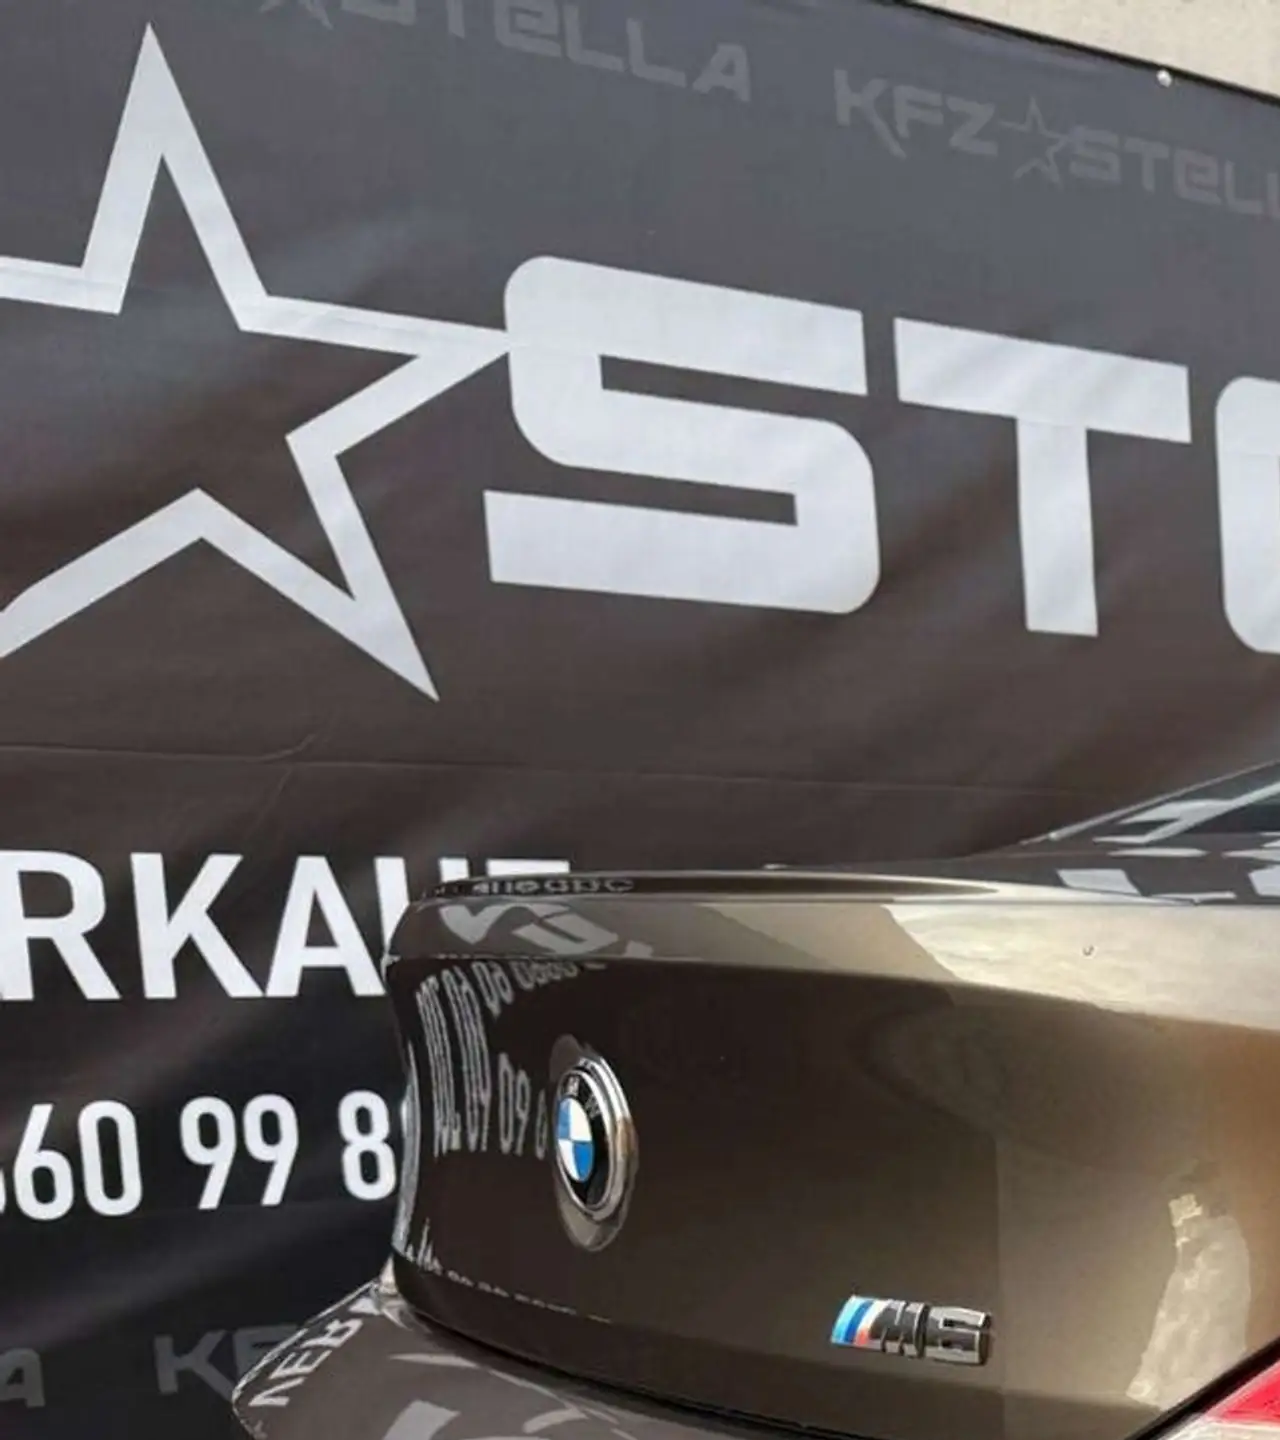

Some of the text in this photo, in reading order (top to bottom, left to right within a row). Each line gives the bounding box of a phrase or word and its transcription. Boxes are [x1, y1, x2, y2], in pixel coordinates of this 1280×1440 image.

[833, 69, 999, 158] KFZ
[0, 850, 571, 1000] RKA
[0, 1090, 397, 1221] 60 99 8
